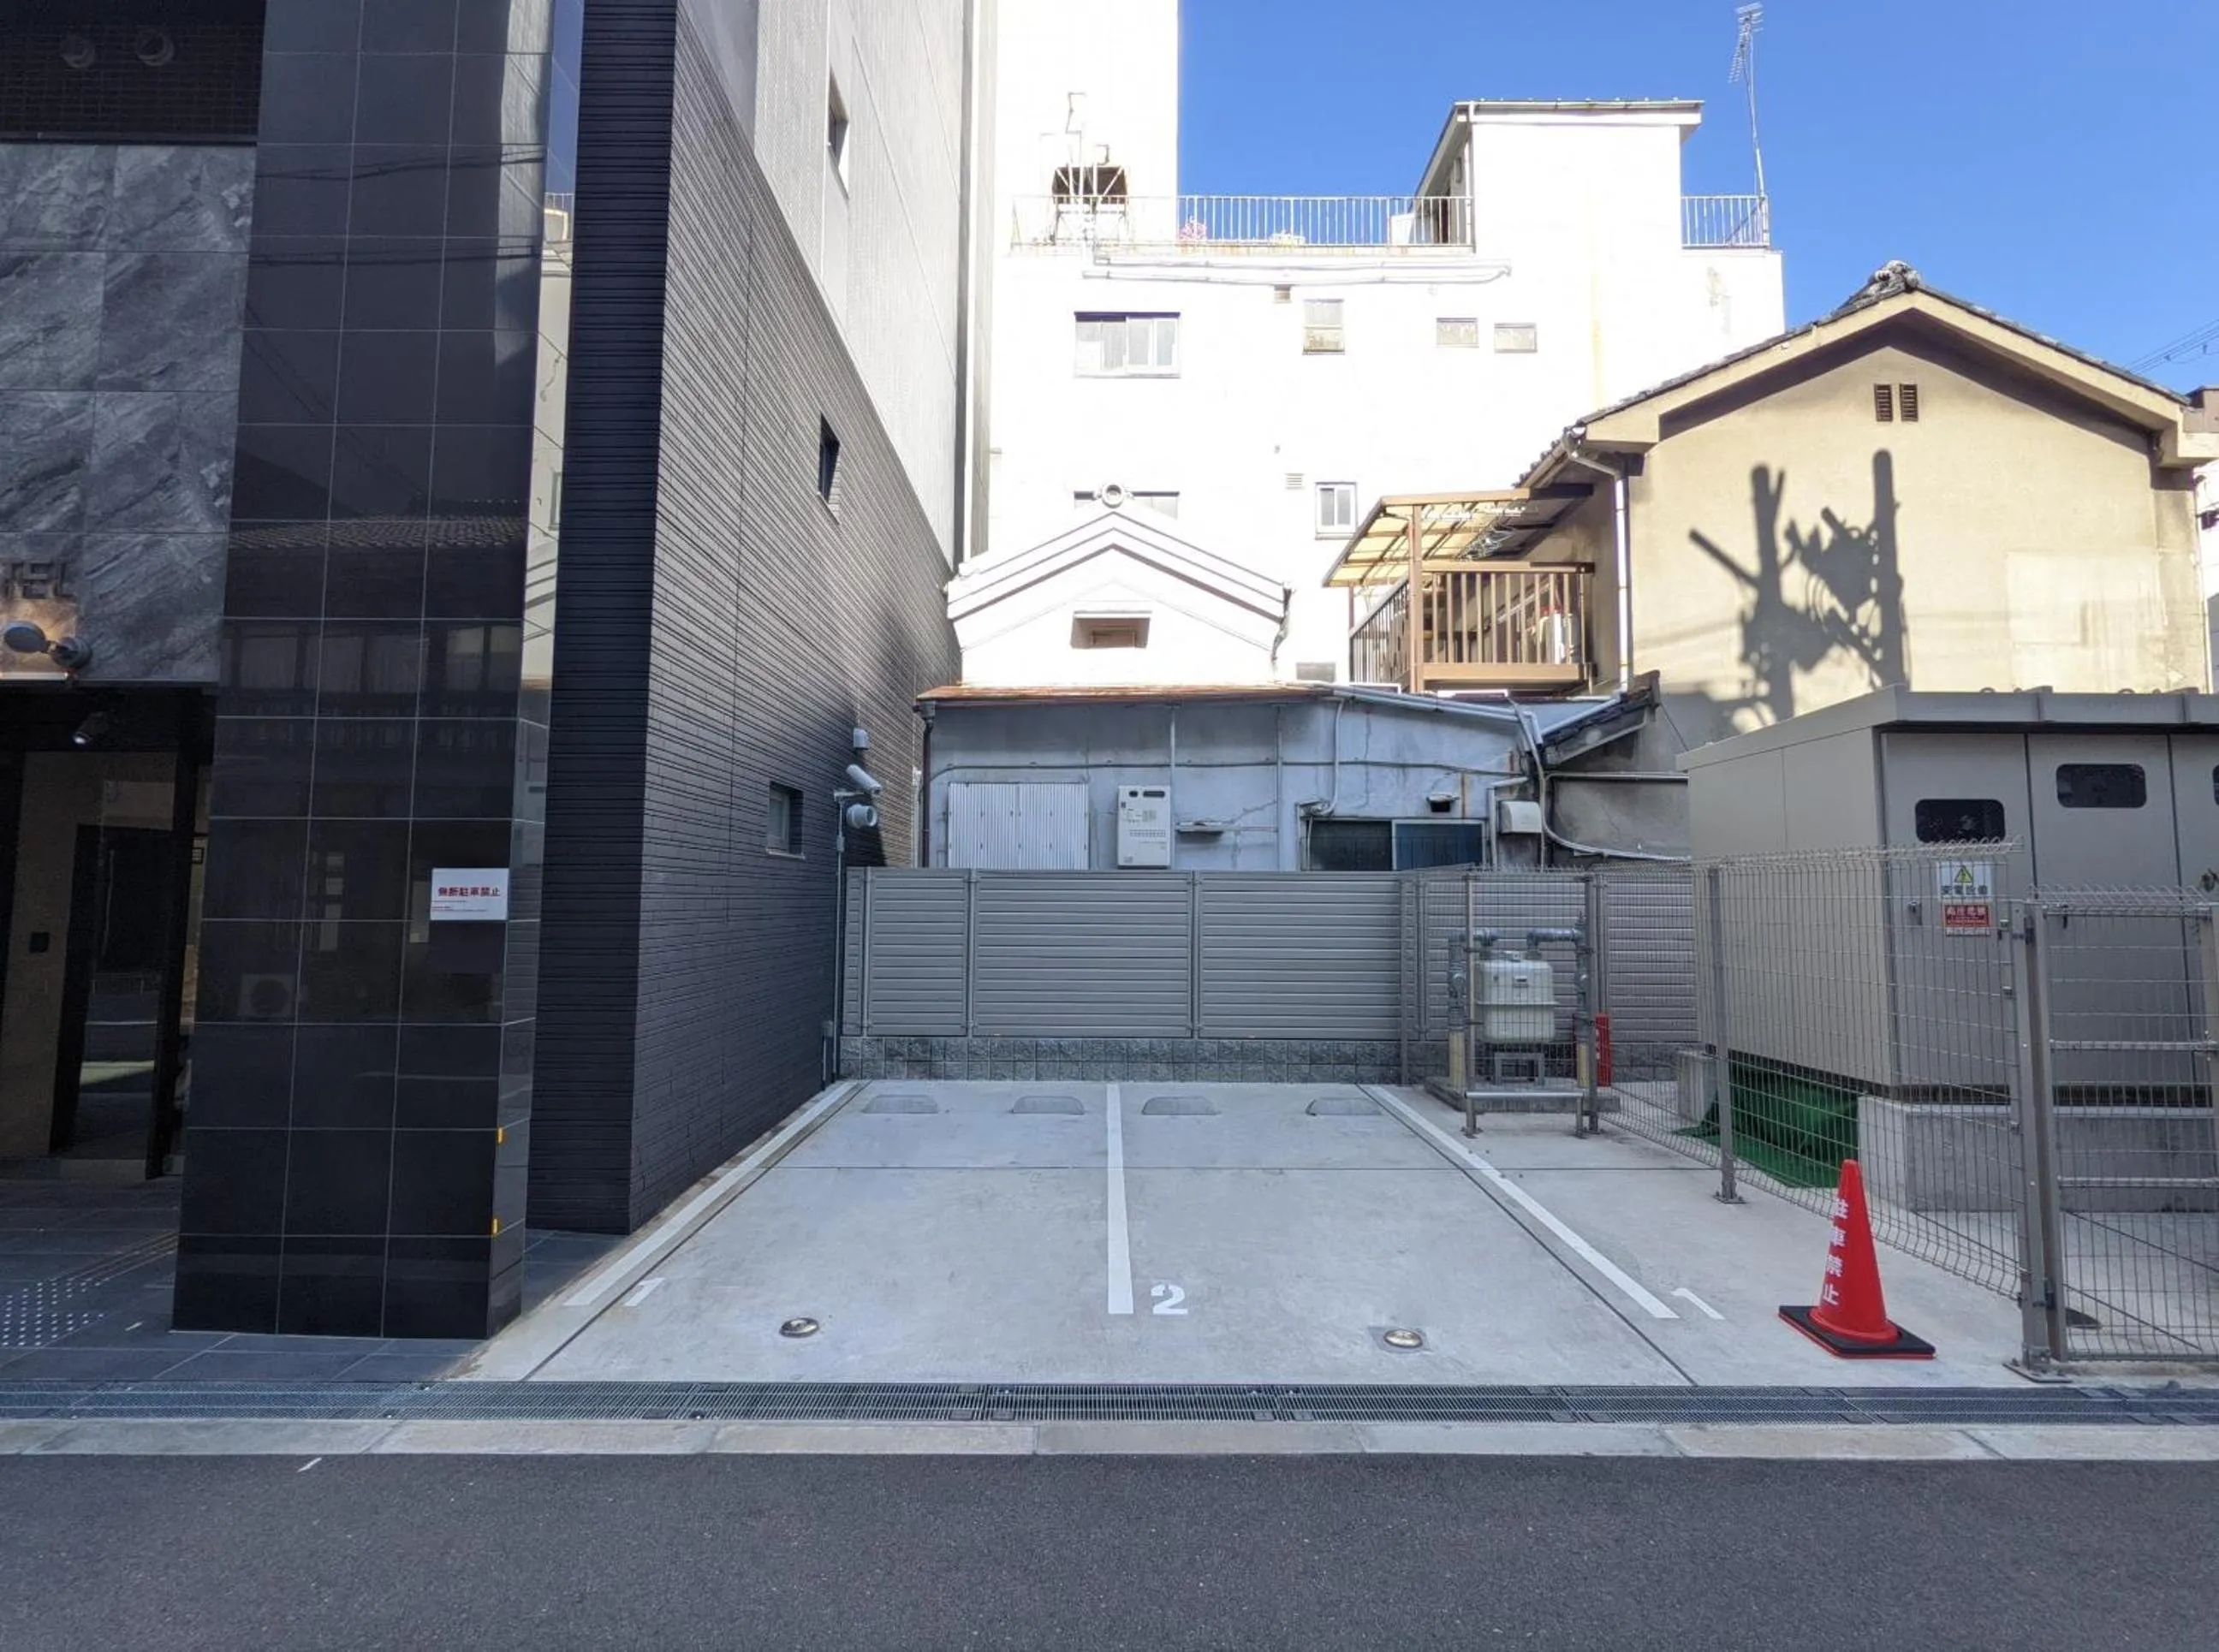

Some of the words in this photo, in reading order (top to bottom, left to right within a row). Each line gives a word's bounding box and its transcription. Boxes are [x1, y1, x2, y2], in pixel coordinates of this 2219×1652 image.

[438, 887, 500, 897] 無断駐車禁止
[1150, 1283, 1189, 1315] 2
